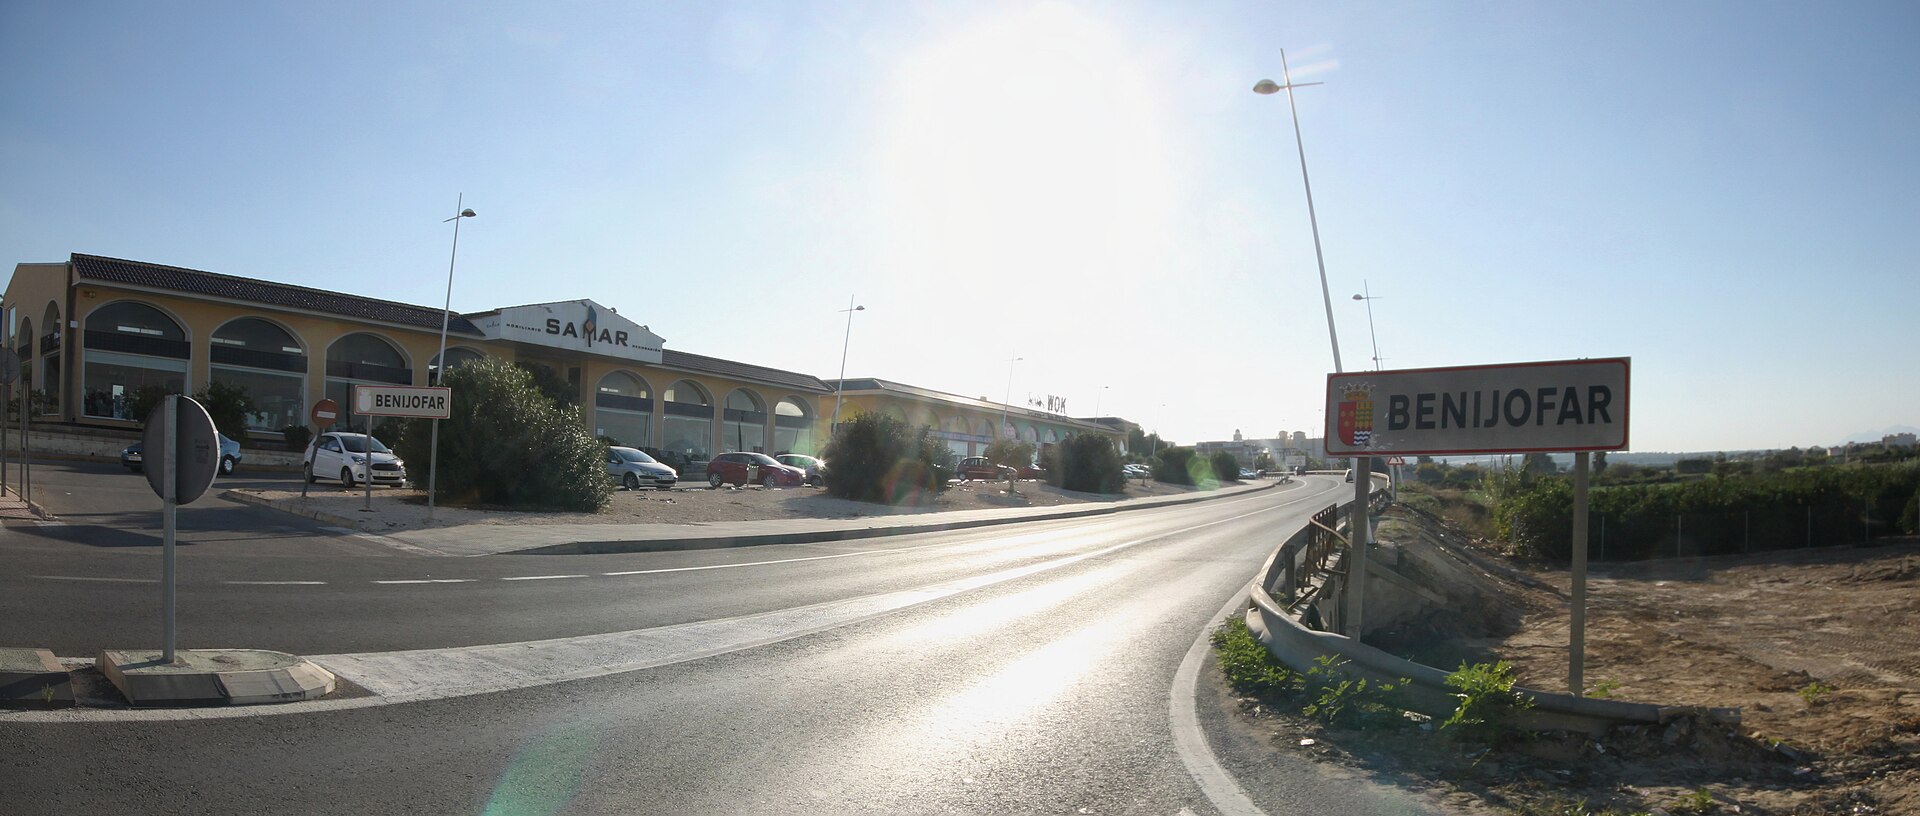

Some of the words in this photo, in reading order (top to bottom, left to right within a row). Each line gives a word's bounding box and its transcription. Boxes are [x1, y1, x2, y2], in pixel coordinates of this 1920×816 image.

[546, 318, 628, 347] SAMAR
[376, 394, 445, 410] BENIJOFAR
[1047, 394, 1067, 414] WOK
[1387, 384, 1613, 431] BENIJOFAR
